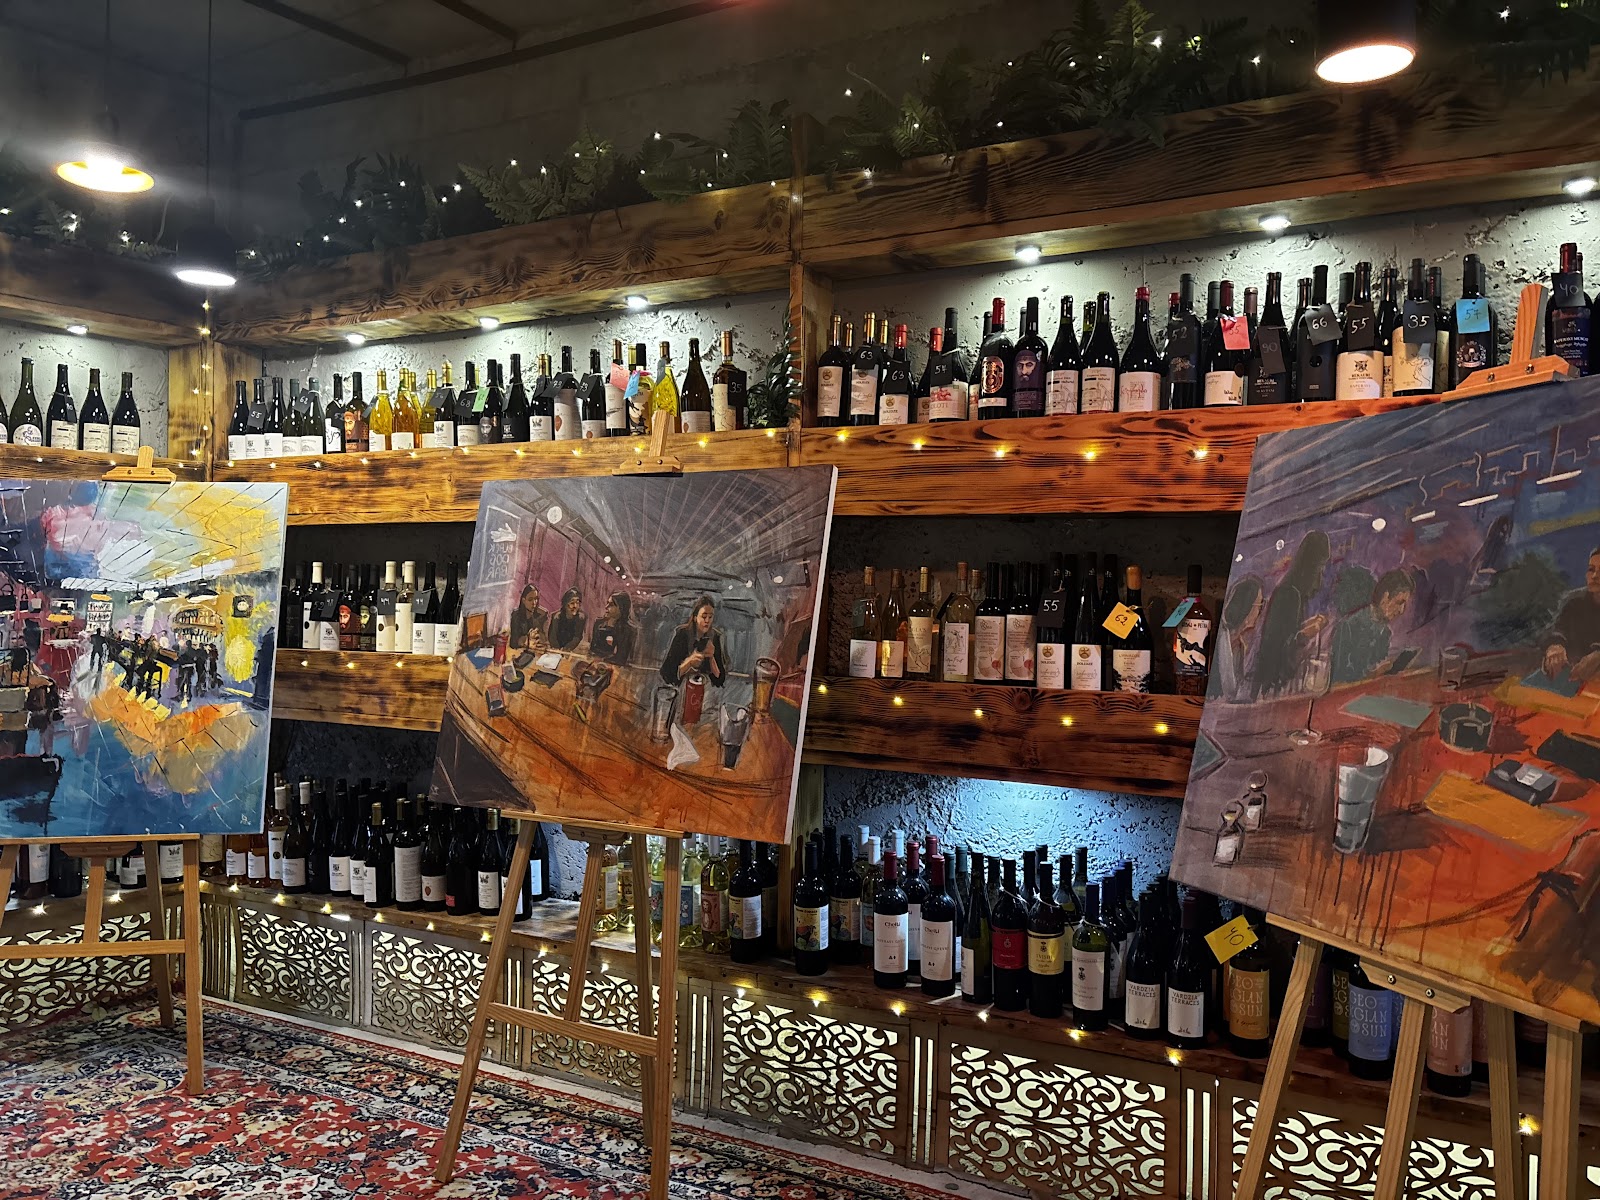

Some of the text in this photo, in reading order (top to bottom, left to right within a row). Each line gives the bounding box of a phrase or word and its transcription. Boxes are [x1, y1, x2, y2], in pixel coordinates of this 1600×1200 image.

[1559, 282, 1579, 297] 40
[1312, 316, 1328, 330] 66
[1351, 316, 1370, 334] 55
[1407, 314, 1431, 329] 35
[1171, 326, 1188, 341] 52
[1262, 341, 1278, 354] 90
[860, 350, 873, 360] 63
[891, 370, 905, 381] 63
[729, 381, 743, 393] 35
[459, 398, 471, 408] 68
[250, 410, 263, 419] 55
[1043, 599, 1060, 612] 55
[1223, 926, 1245, 946] 40
[1128, 988, 1156, 998] TERRACES
[1129, 983, 1155, 992] VARDZIA
[1171, 996, 1200, 1006] TERRACES
[1172, 991, 1198, 1000] VARDZIA
[1350, 990, 1377, 1010] GEO
[1239, 1003, 1264, 1017] SUN
[1361, 1022, 1388, 1038] SUN
